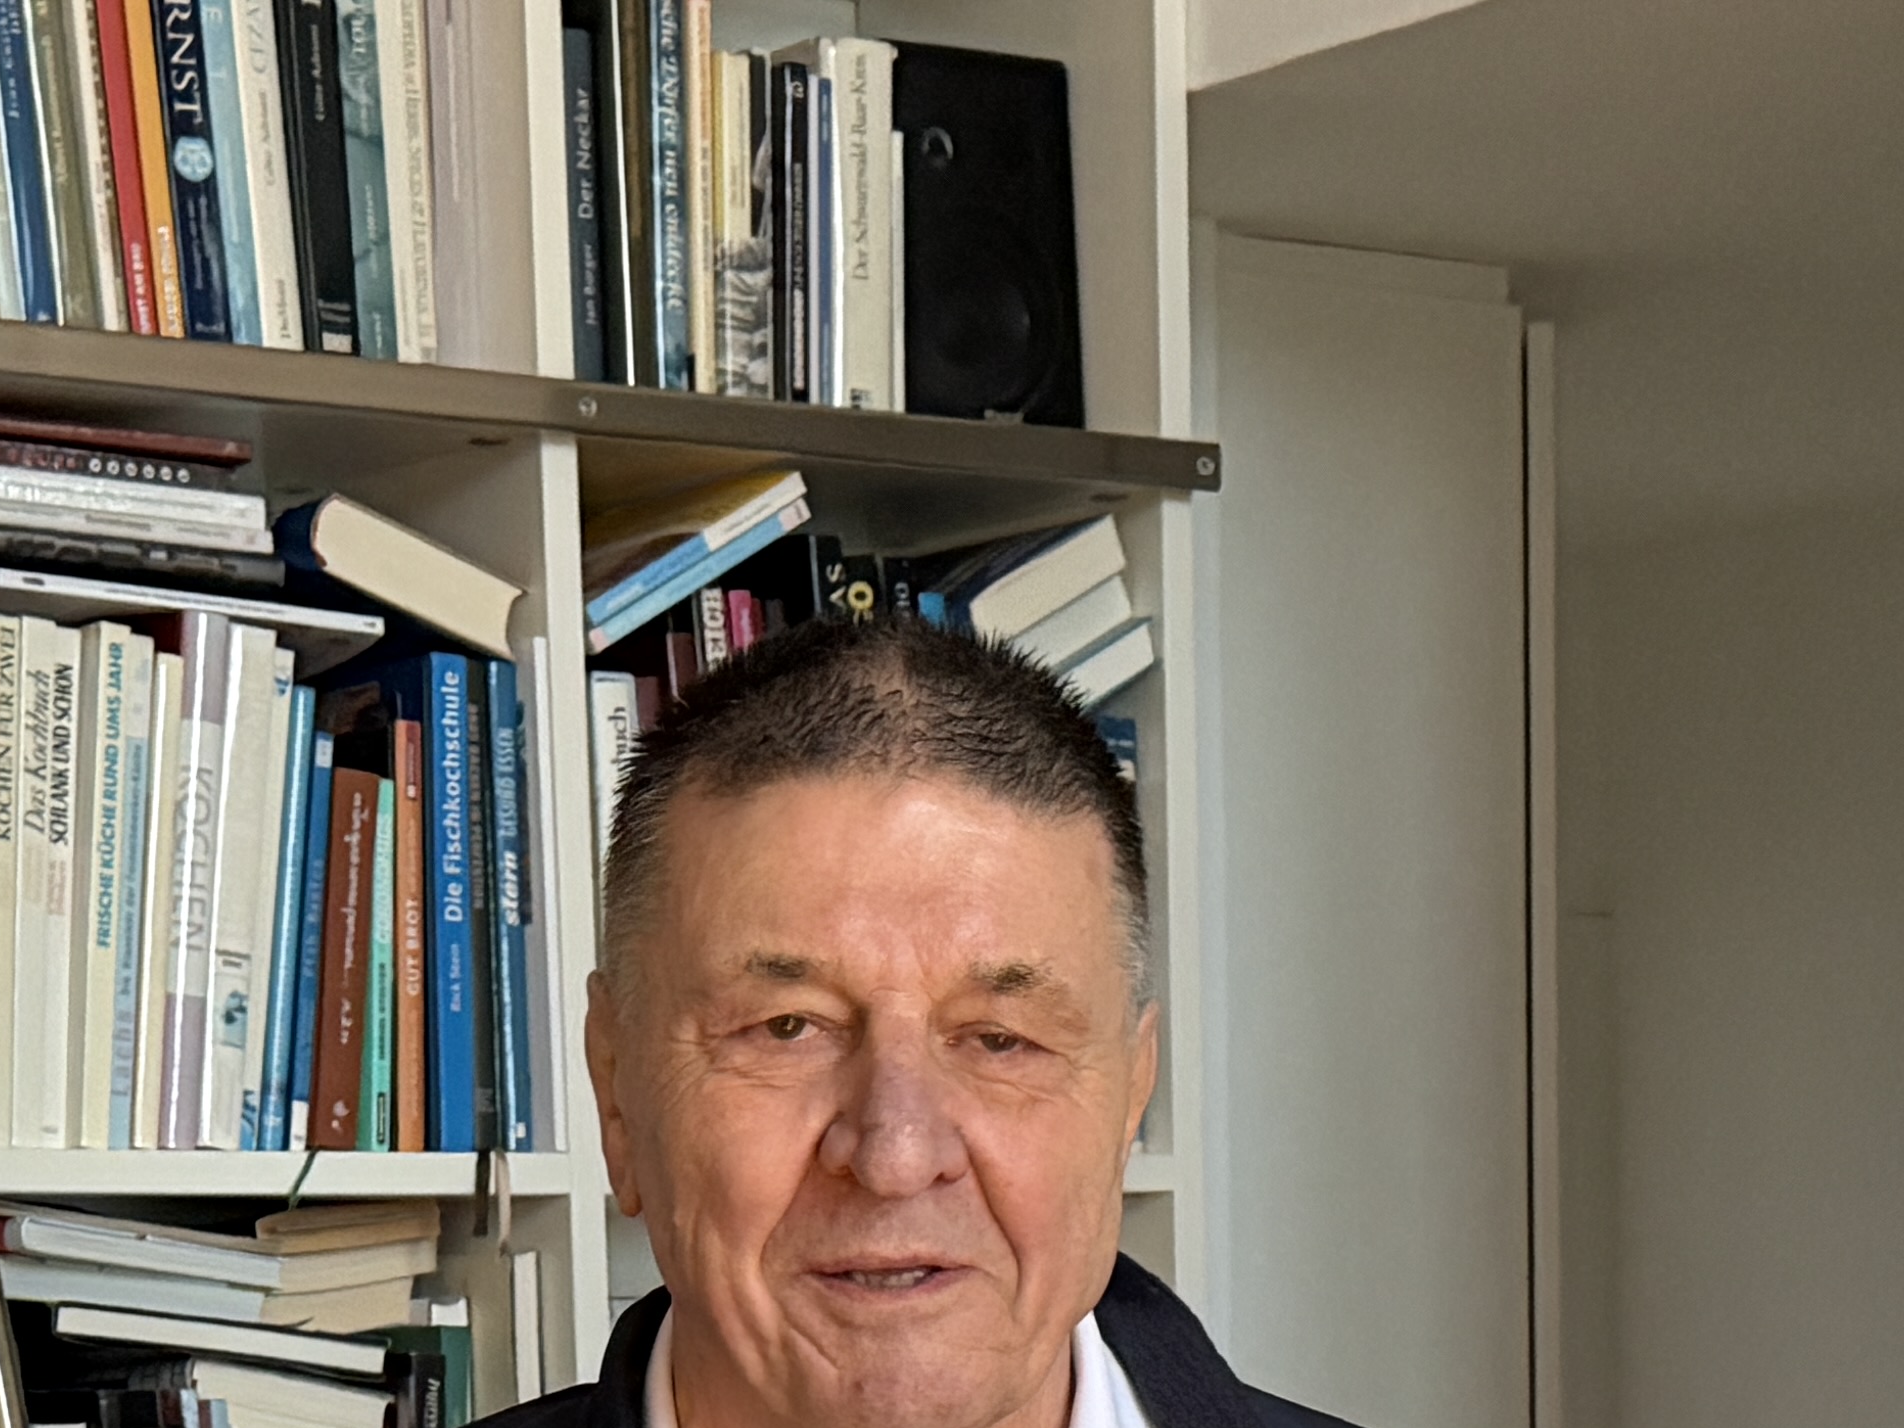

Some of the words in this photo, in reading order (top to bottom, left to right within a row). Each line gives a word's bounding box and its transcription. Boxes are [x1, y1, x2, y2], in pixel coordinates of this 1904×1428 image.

[574, 87, 593, 170] Neckar
[577, 191, 595, 219] Der
[105, 642, 124, 691] JAHR
[22, 668, 52, 779] Kochbuch
[52, 724, 71, 765] UND
[102, 692, 121, 742] UMS
[100, 744, 119, 803] RUND
[440, 670, 462, 874] Fischkochschule
[21, 785, 47, 835] Das
[48, 765, 71, 846] SCHLANK
[93, 804, 116, 870] KÜCHE
[170, 763, 214, 954] KOCHEN
[95, 871, 115, 950] FRISCHE
[442, 878, 463, 923] Die
[499, 851, 520, 927] stern
[404, 898, 419, 950] BROT
[404, 953, 420, 997] GUT
